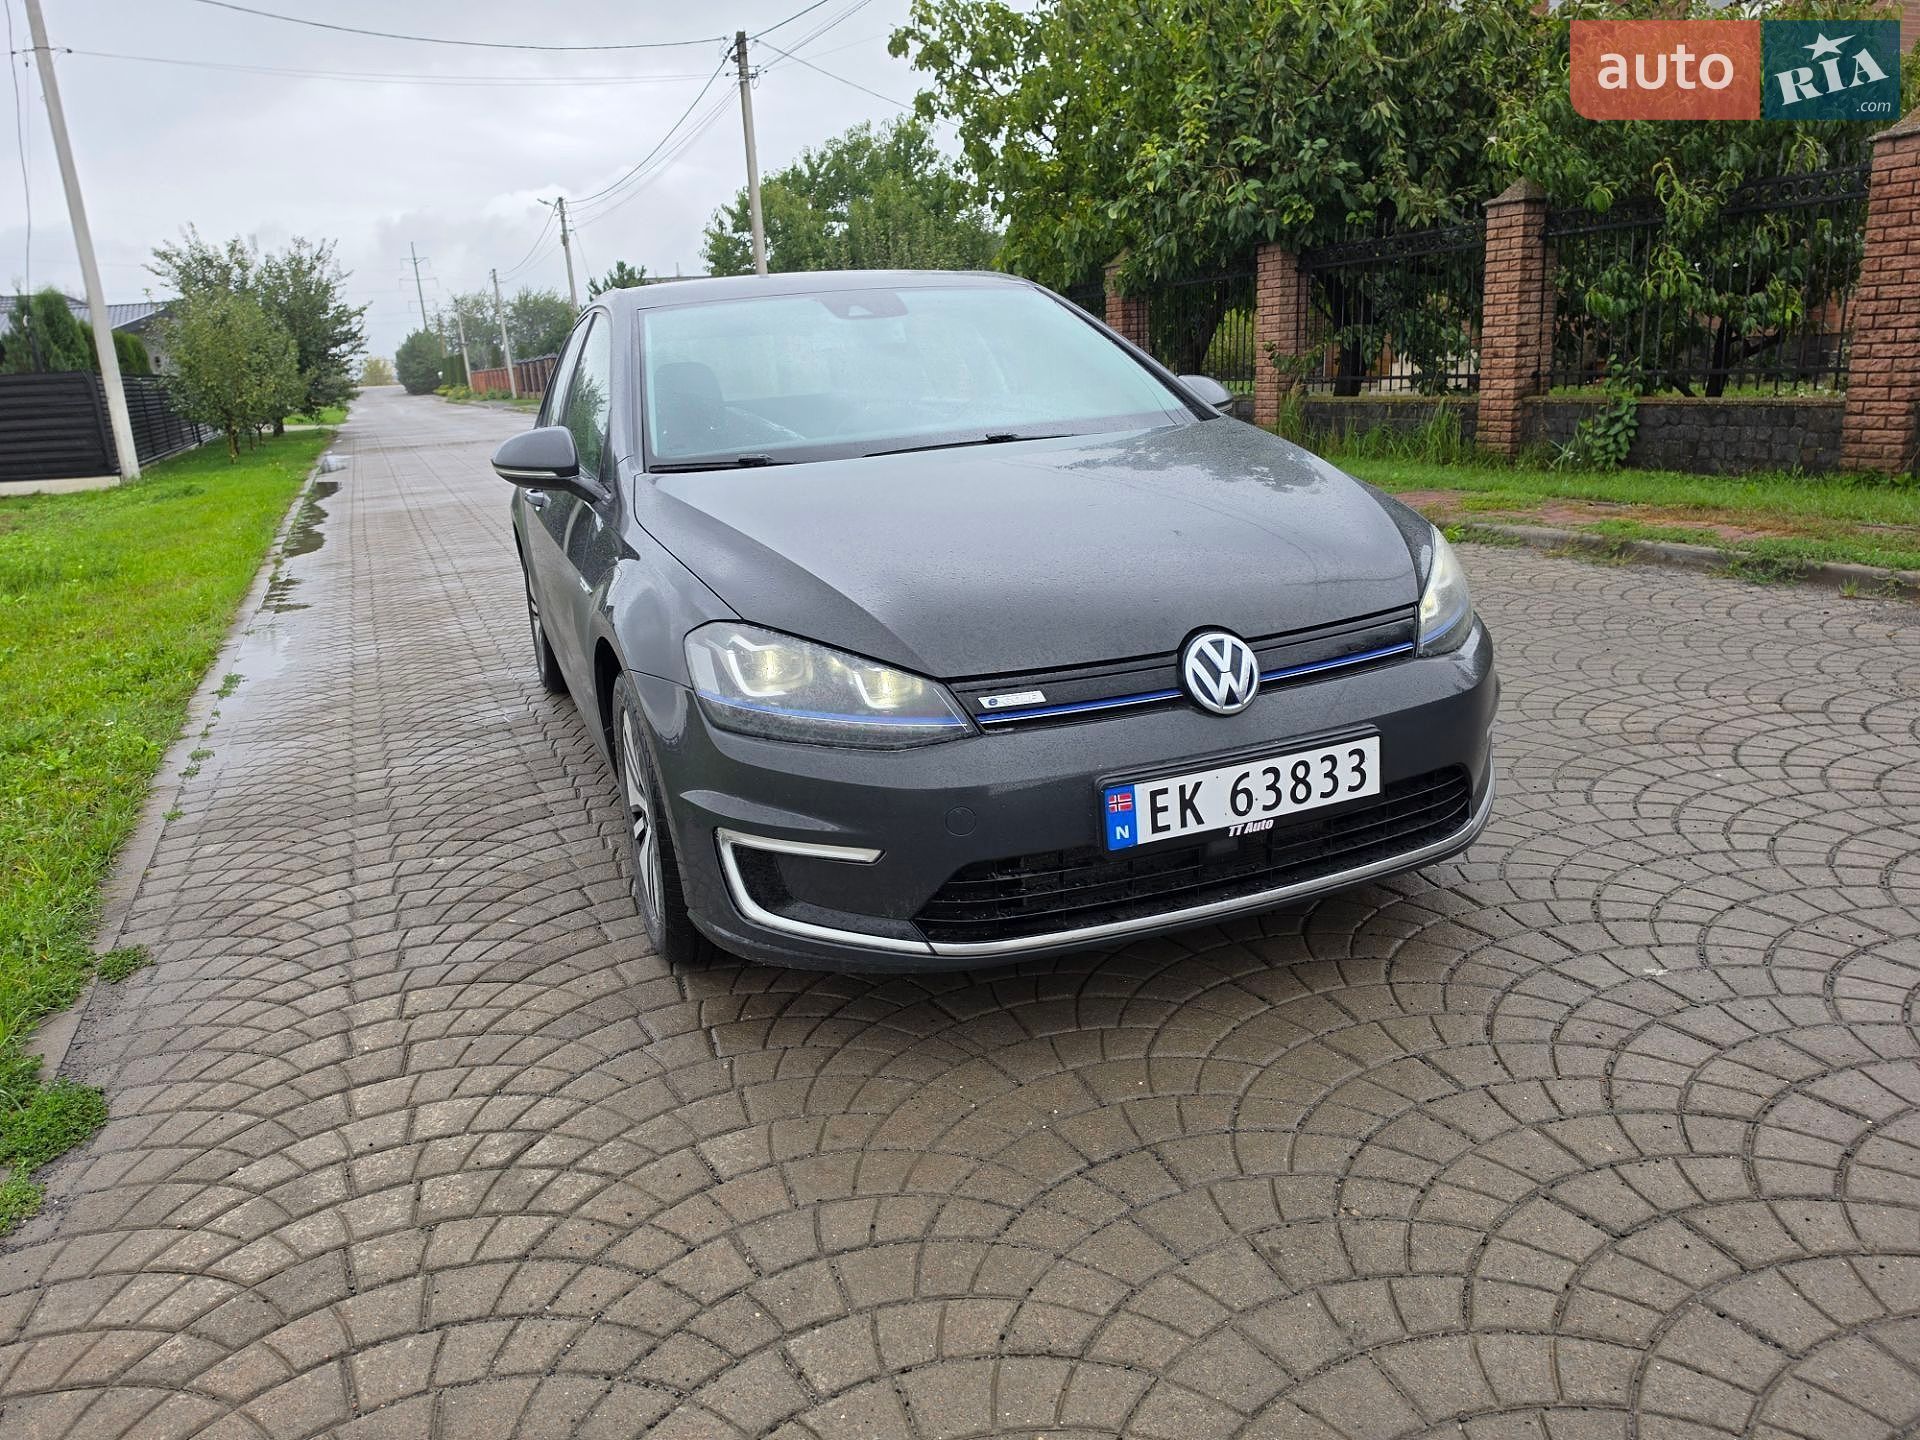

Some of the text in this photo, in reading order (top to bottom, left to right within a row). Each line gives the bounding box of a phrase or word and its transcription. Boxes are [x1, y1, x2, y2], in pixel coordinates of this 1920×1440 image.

[1149, 748, 1367, 834] EK 63833
[1115, 824, 1129, 839] N
[1244, 819, 1274, 834] Auto
